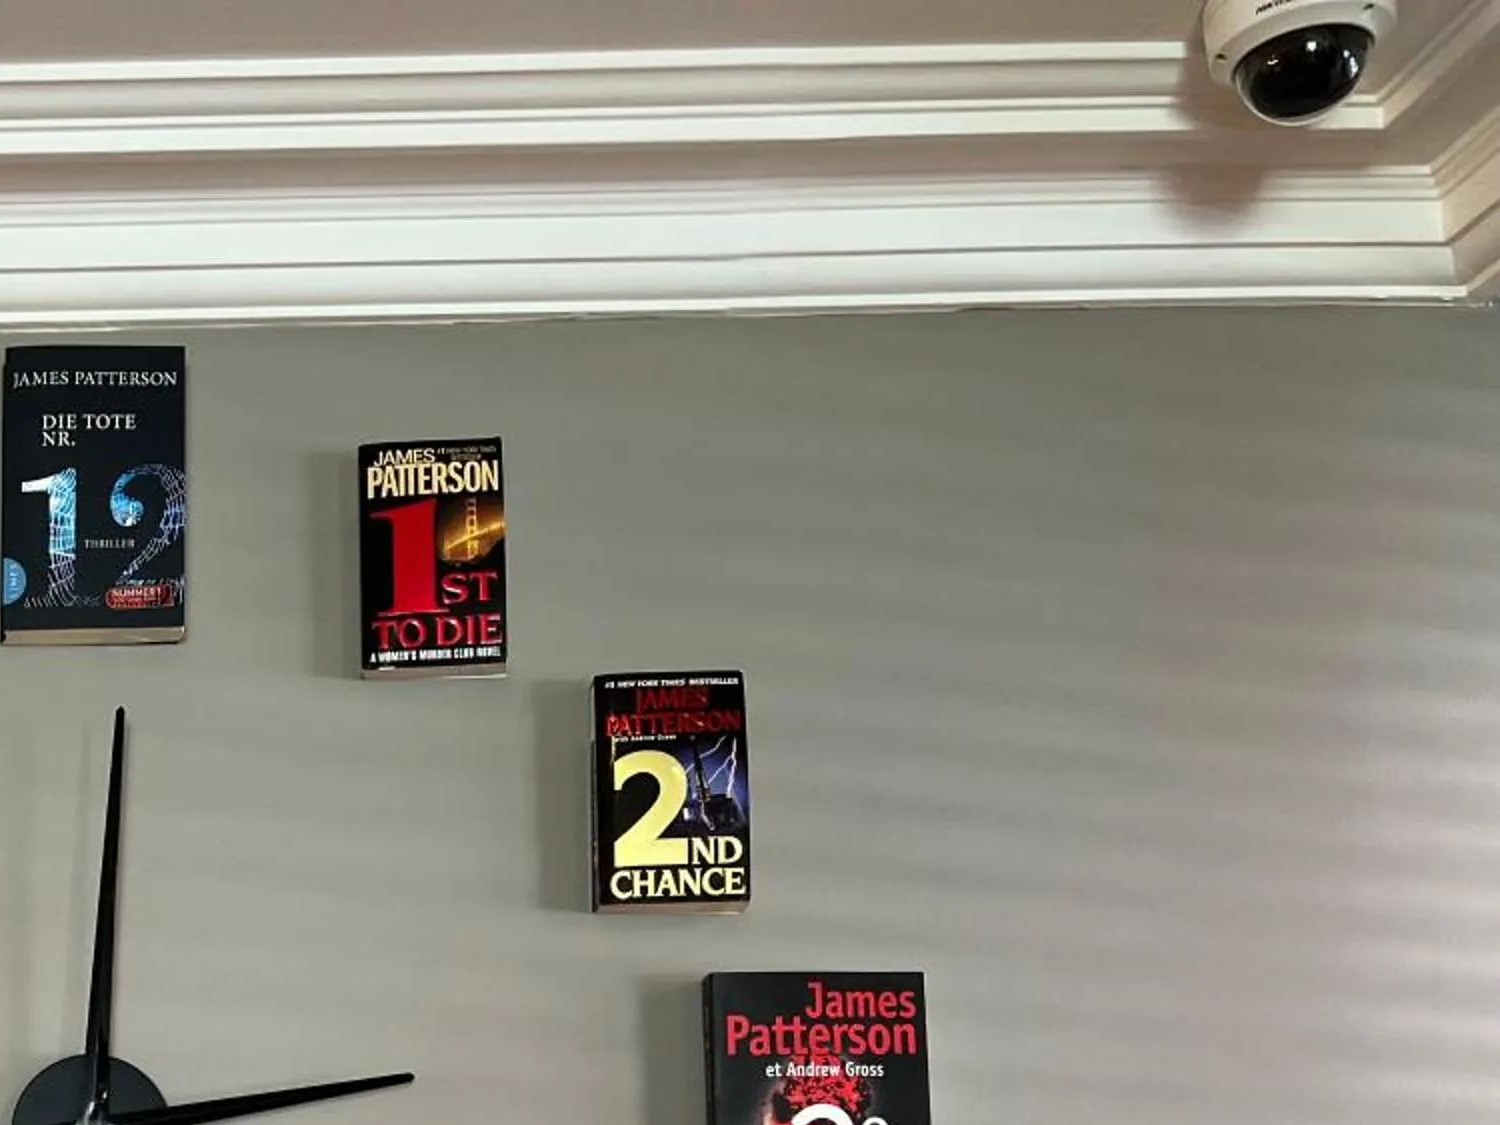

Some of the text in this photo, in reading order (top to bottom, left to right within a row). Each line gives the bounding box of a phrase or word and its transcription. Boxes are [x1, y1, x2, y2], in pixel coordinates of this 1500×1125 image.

[13, 371, 178, 389] JAMES PATTERSON
[42, 413, 137, 430] DIE TOTE
[42, 431, 76, 447] NR.
[374, 448, 436, 467] JAMES
[367, 460, 499, 499] PATTERSON
[372, 614, 502, 649] TO DIE
[370, 653, 376, 662] A
[661, 679, 685, 687] TIMES
[635, 687, 709, 709] JAMES
[606, 710, 741, 737] PATTERSON
[610, 867, 746, 900] CHANCE
[805, 981, 917, 1018] James
[726, 1015, 917, 1056] Patterson
[765, 1061, 885, 1077] et Andrew Gross
